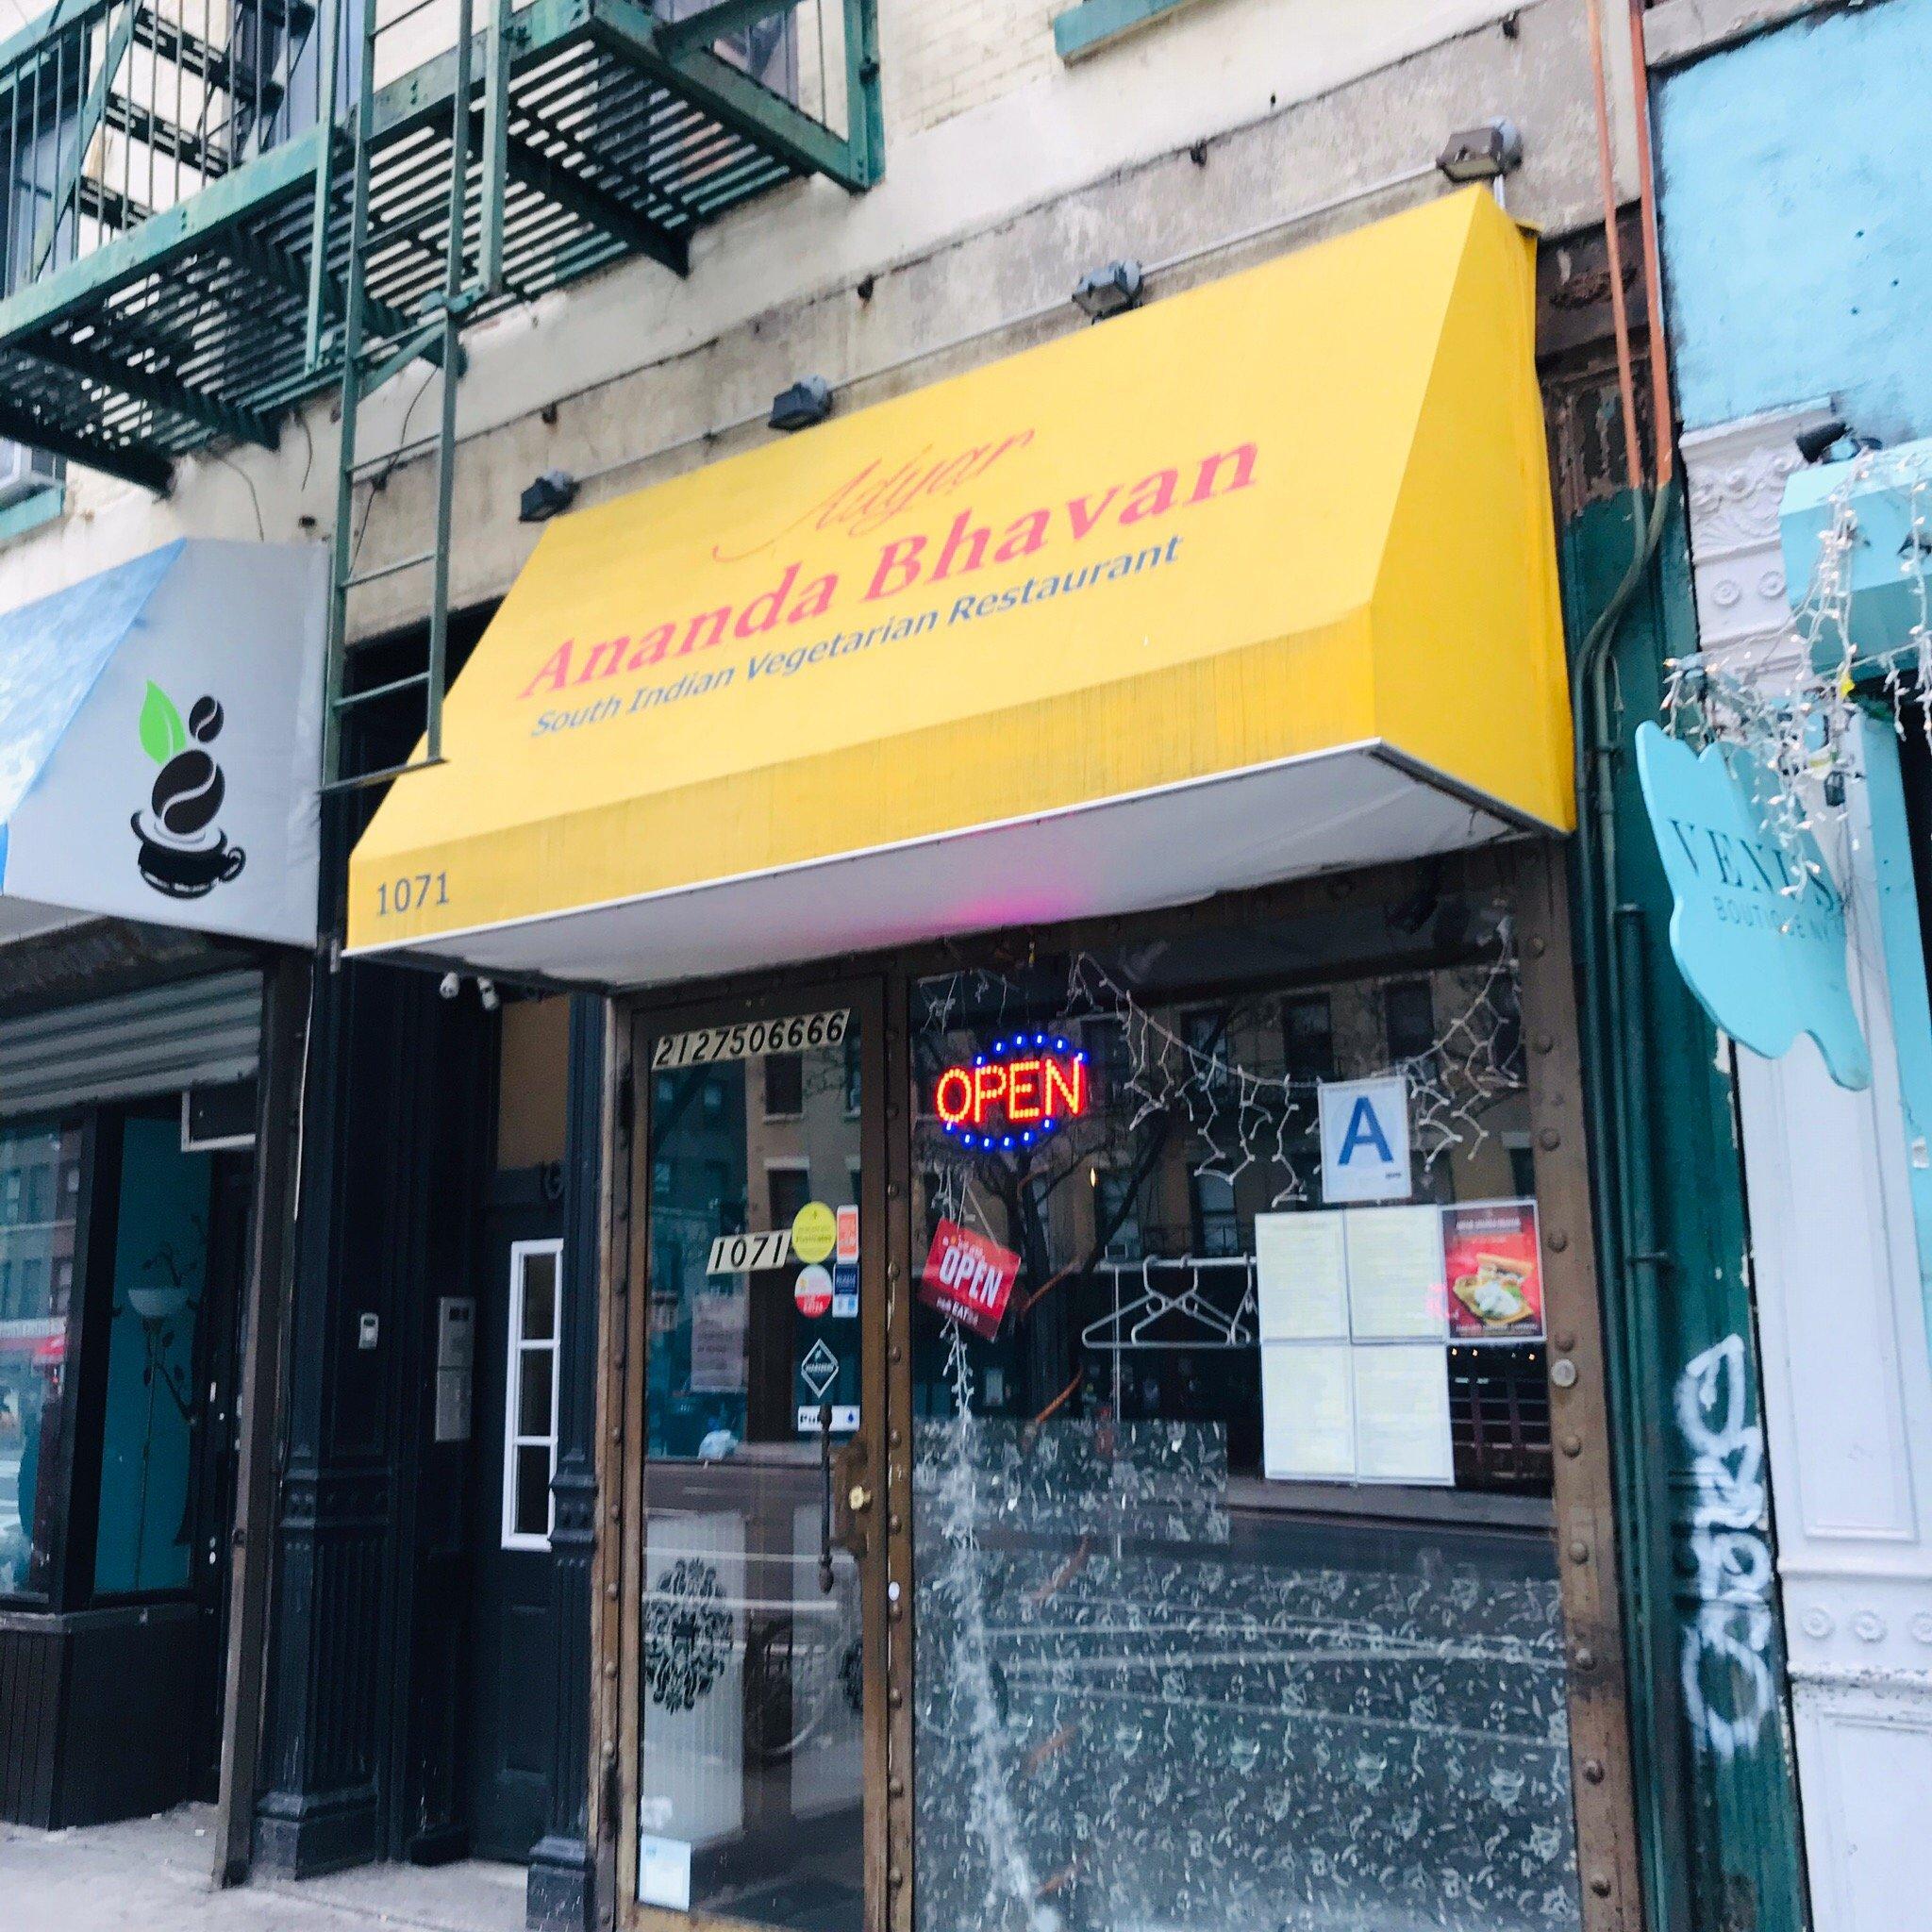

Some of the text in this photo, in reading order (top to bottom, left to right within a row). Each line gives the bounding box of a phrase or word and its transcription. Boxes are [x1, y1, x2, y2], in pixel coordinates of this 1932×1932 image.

[712, 428, 1036, 563] Adyar
[517, 441, 1259, 700] Ananda Bhavan
[531, 533, 1185, 738] South Indian Vegetarian Restaurant
[377, 871, 450, 916] 1071
[656, 1010, 845, 1066] 2127506666
[935, 1056, 1084, 1125] OPEN
[1337, 1096, 1394, 1167] A
[714, 1232, 784, 1270] 1071
[939, 1245, 1004, 1309] OPEN
